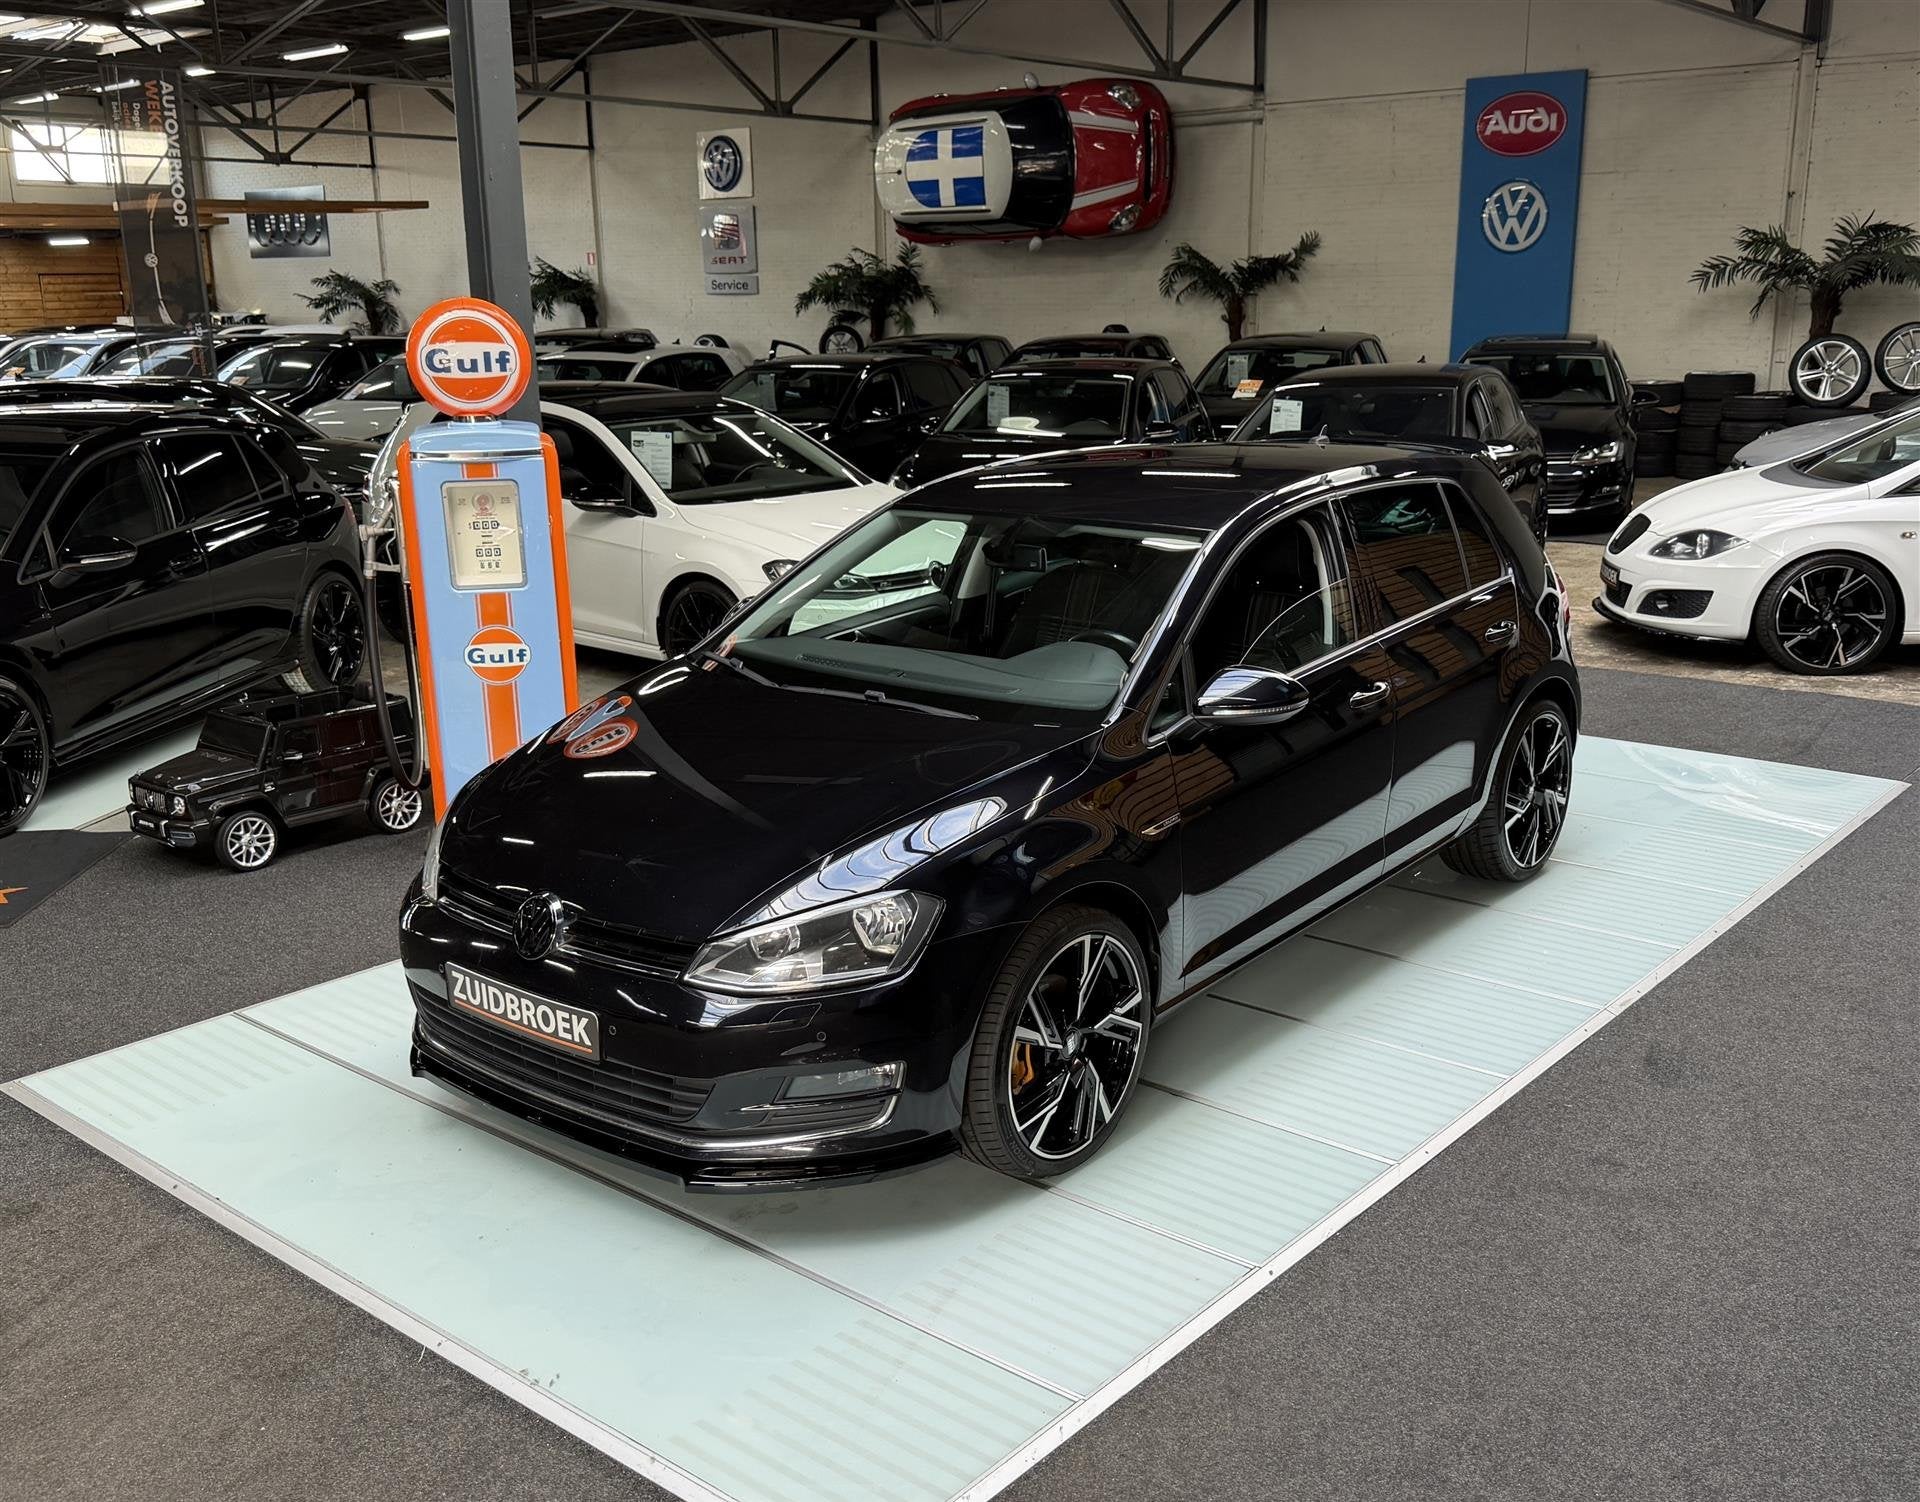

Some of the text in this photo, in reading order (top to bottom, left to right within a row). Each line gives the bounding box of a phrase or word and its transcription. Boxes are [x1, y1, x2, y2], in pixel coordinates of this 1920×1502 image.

[1484, 106, 1559, 136] Audi
[159, 80, 189, 228] AUTOVERKOOP
[711, 256, 747, 265] SEAT
[711, 280, 749, 290] Service
[425, 348, 510, 373] Gulf
[467, 647, 528, 664] Gulf
[451, 970, 592, 1046] ZUIDBROEK
